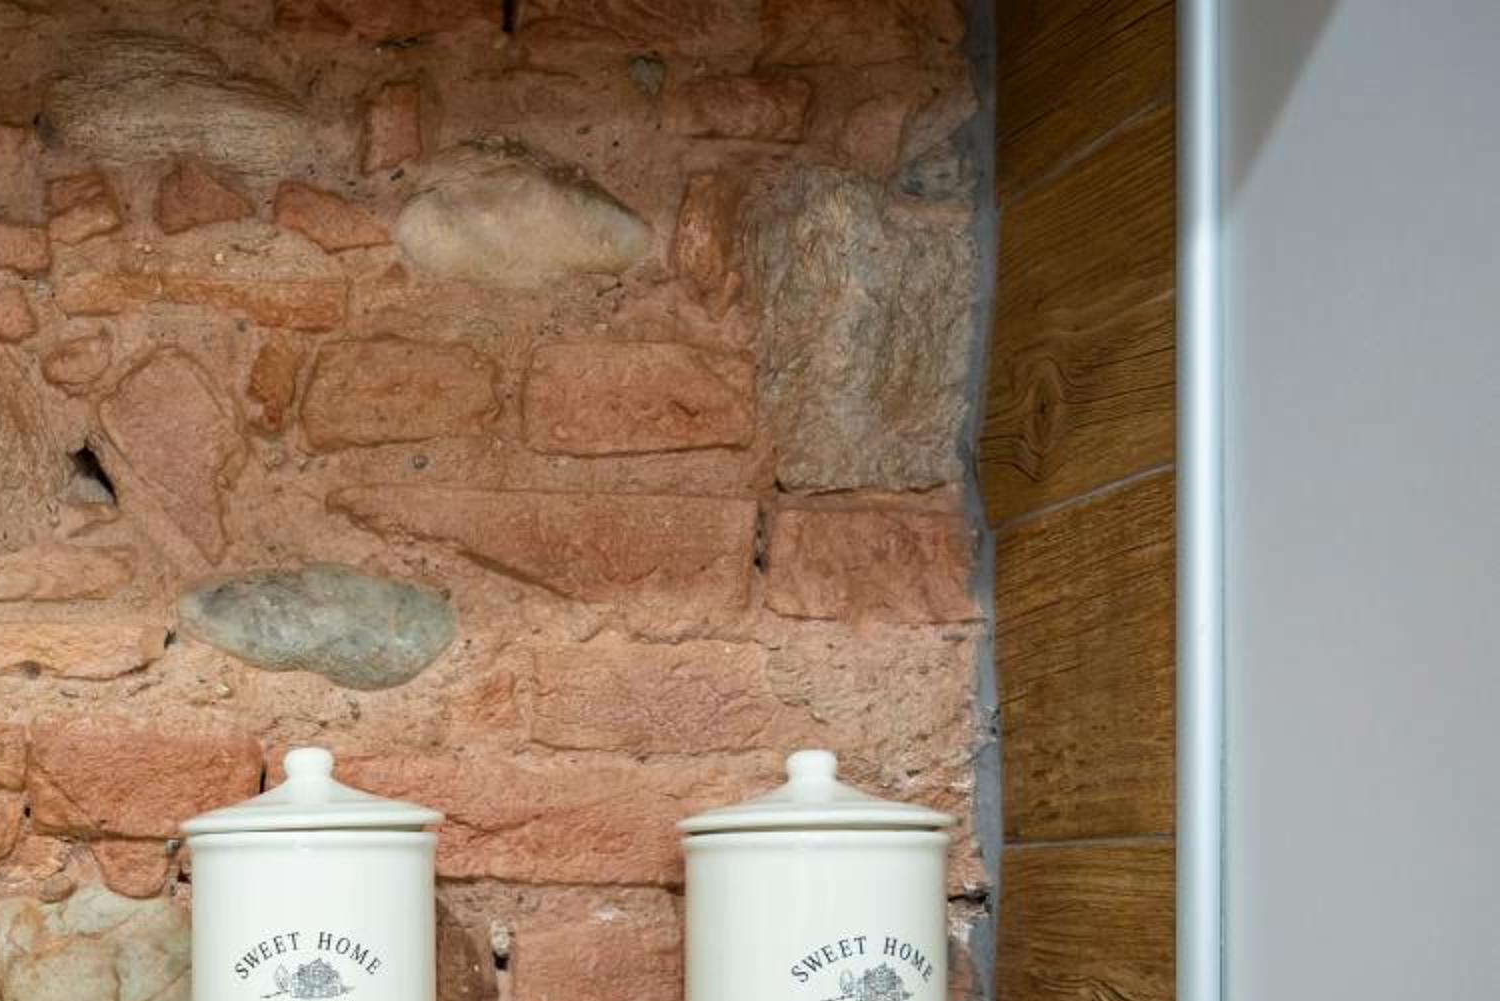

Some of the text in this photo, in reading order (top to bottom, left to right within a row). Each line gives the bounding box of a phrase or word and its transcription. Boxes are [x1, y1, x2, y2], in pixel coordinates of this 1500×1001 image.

[234, 931, 382, 980] SWEET HOME
[791, 935, 933, 984] SWEET HOME
